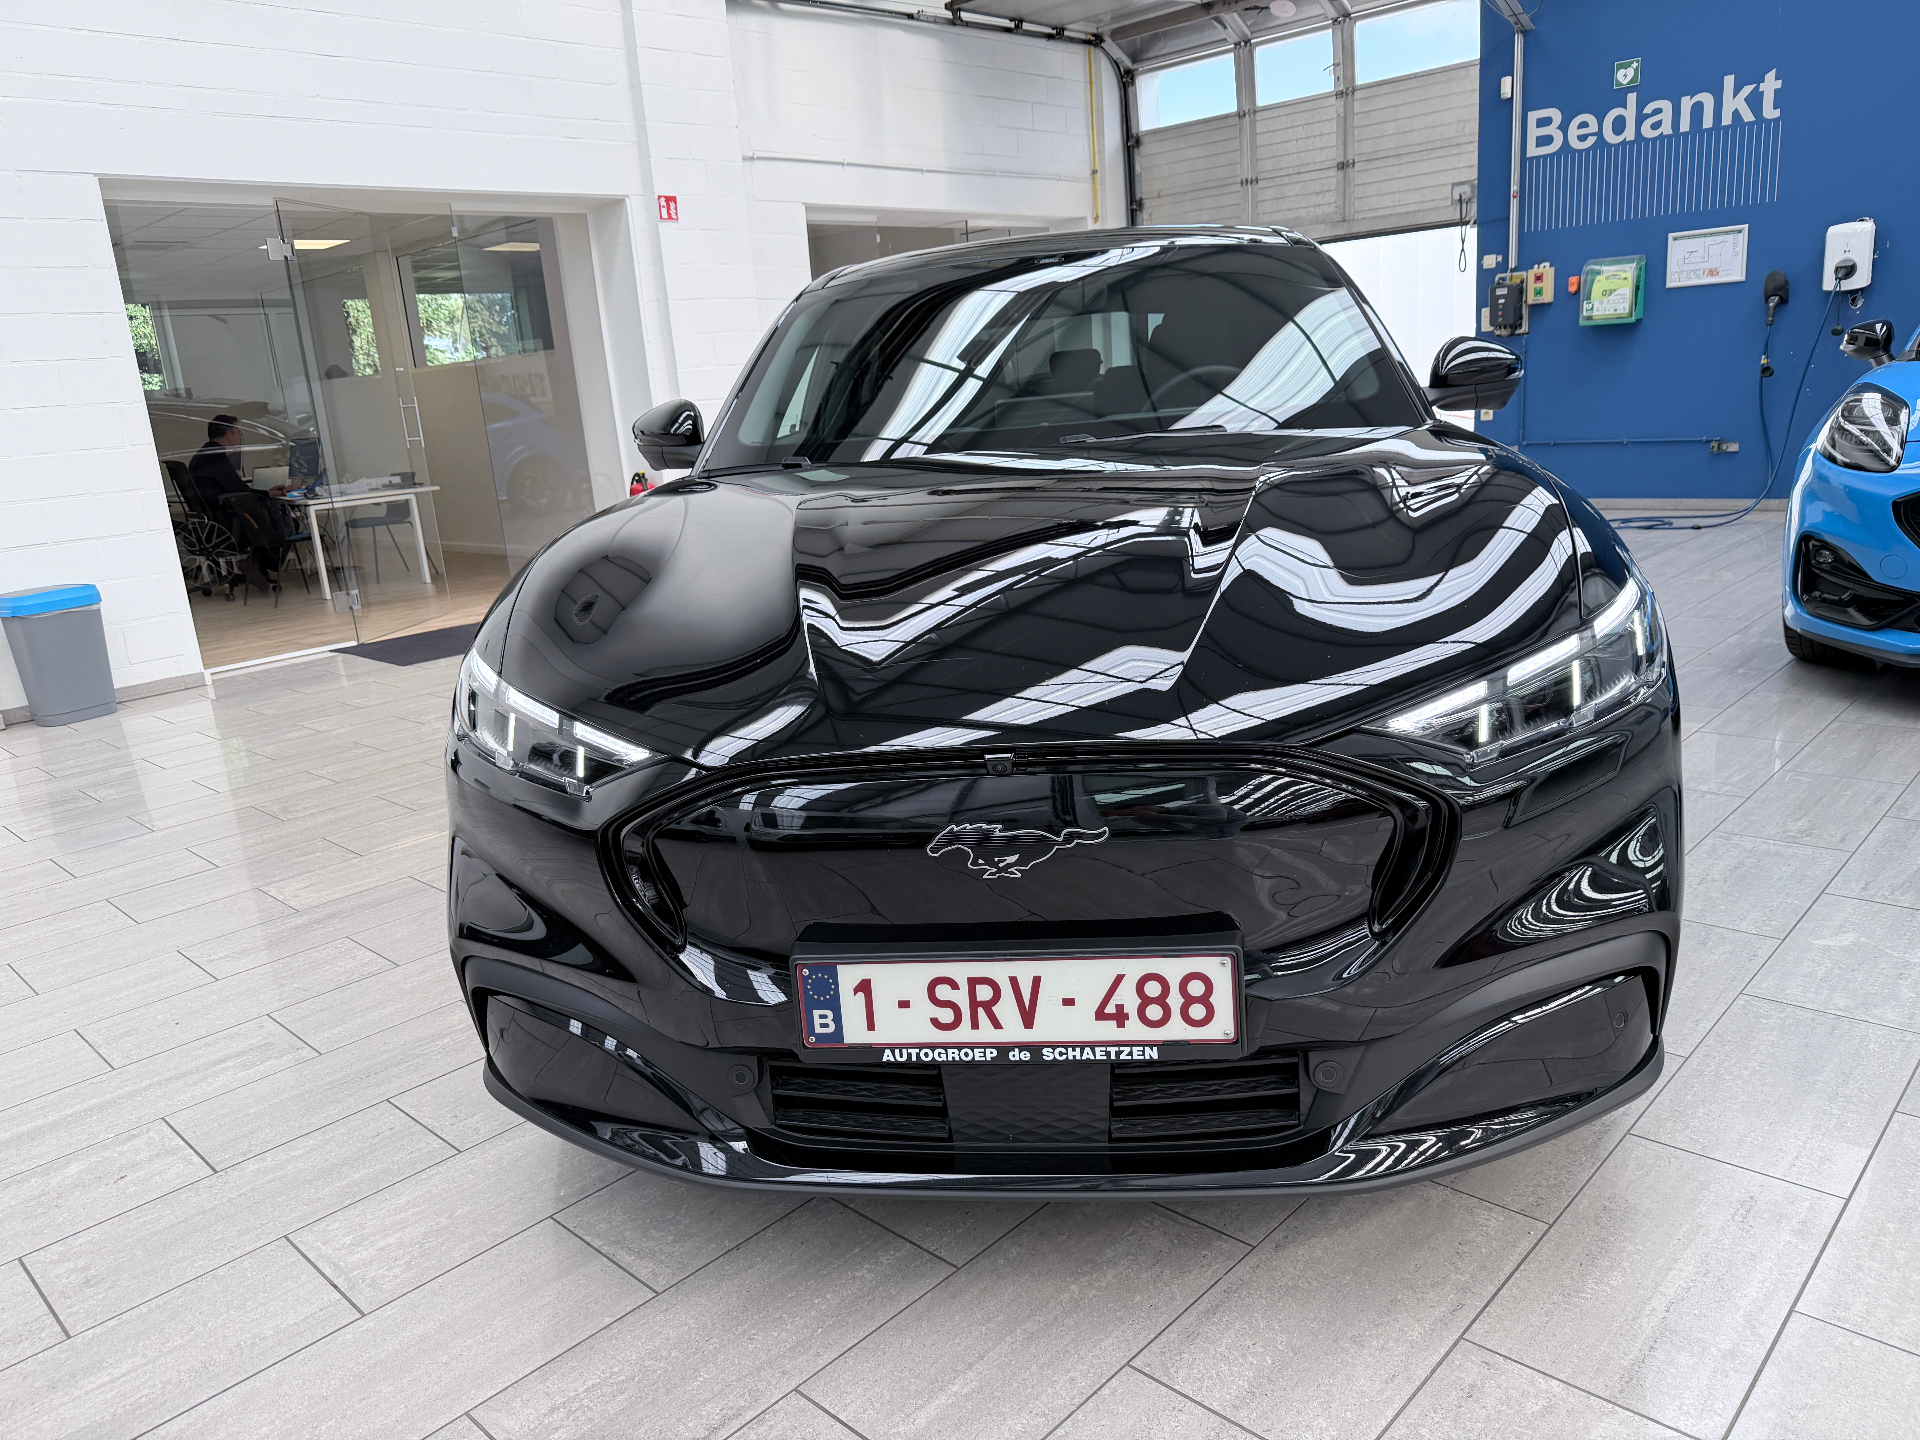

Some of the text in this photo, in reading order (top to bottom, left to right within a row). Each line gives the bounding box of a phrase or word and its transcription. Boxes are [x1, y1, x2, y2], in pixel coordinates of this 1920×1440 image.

[1527, 68, 1783, 157] Bedankt
[813, 1010, 836, 1034] B
[882, 1046, 1159, 1062] AUTOGROEP de SCHAETZEN
